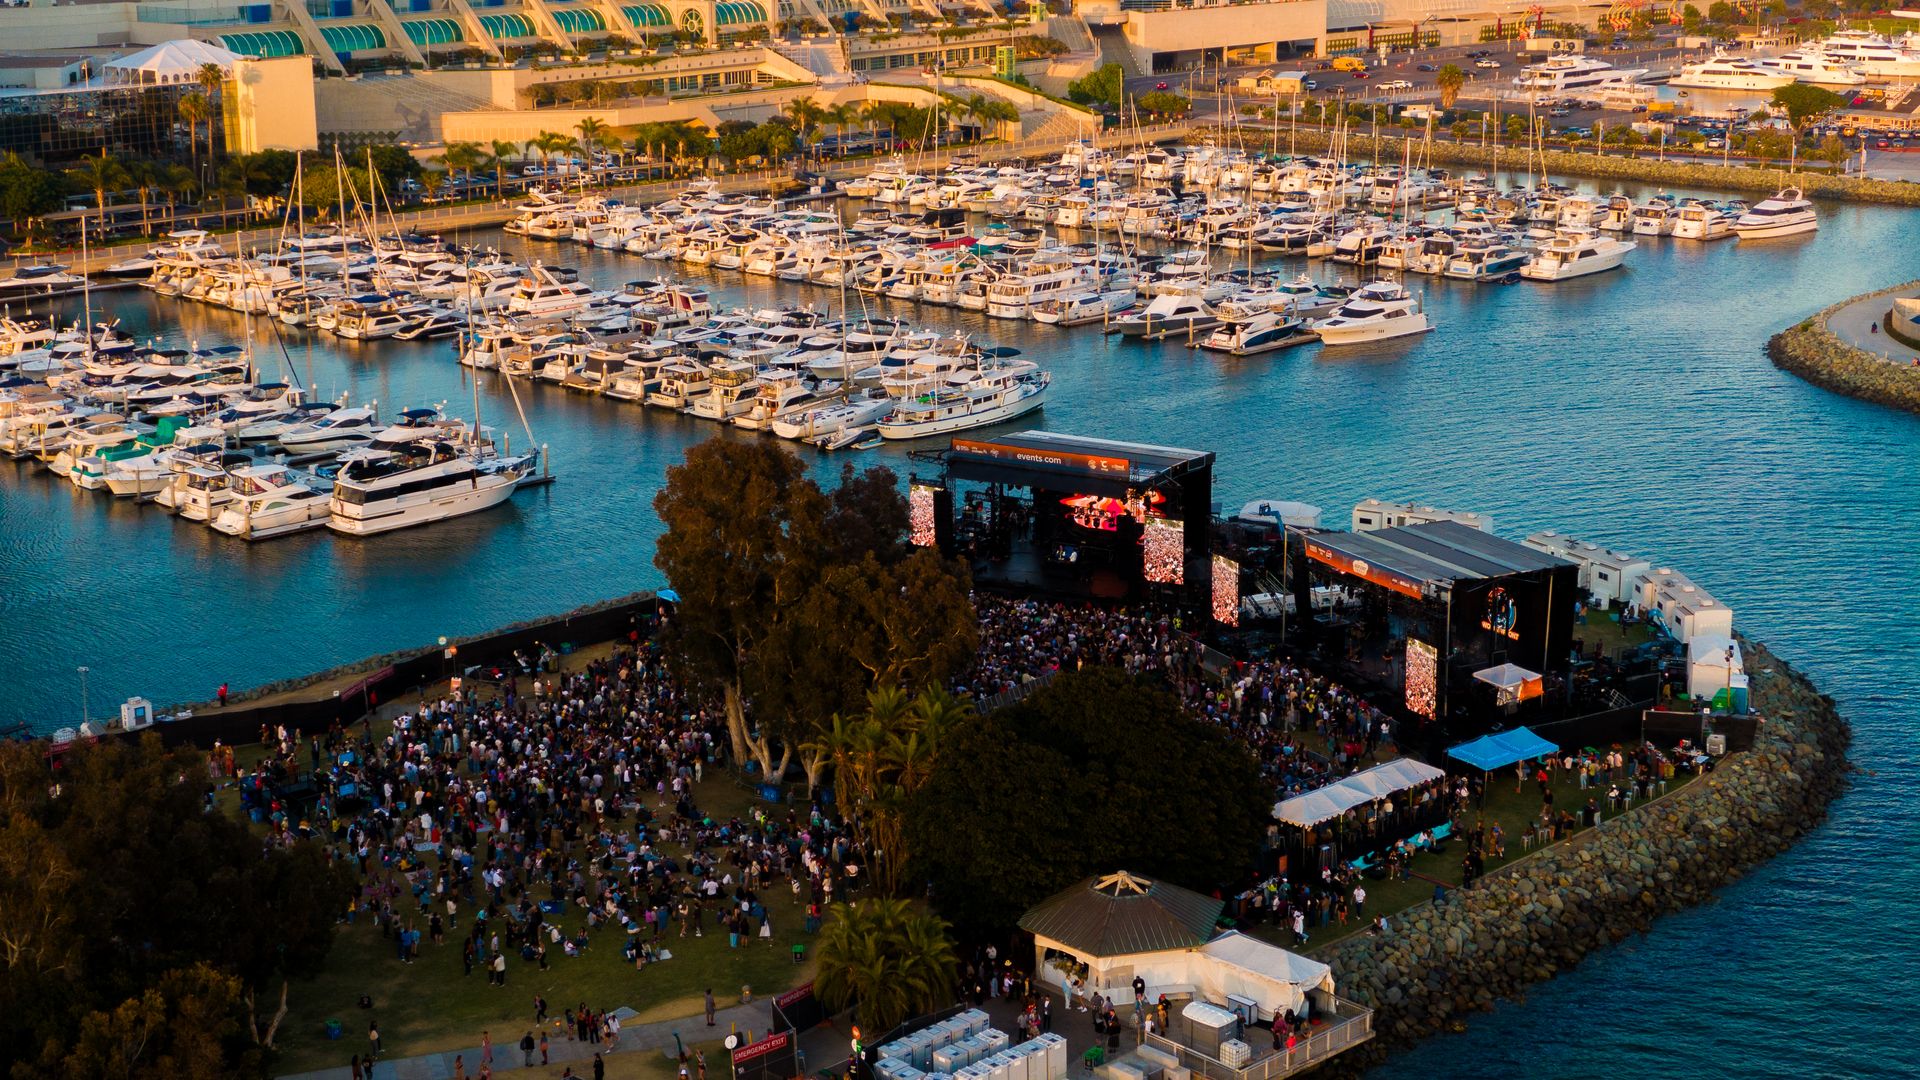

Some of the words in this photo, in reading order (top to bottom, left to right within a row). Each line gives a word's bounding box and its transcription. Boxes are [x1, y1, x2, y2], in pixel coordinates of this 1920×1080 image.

[1016, 453, 1062, 464] events.com
[734, 1042, 771, 1060] EMERGENCY
[771, 1036, 785, 1047] EXIT
